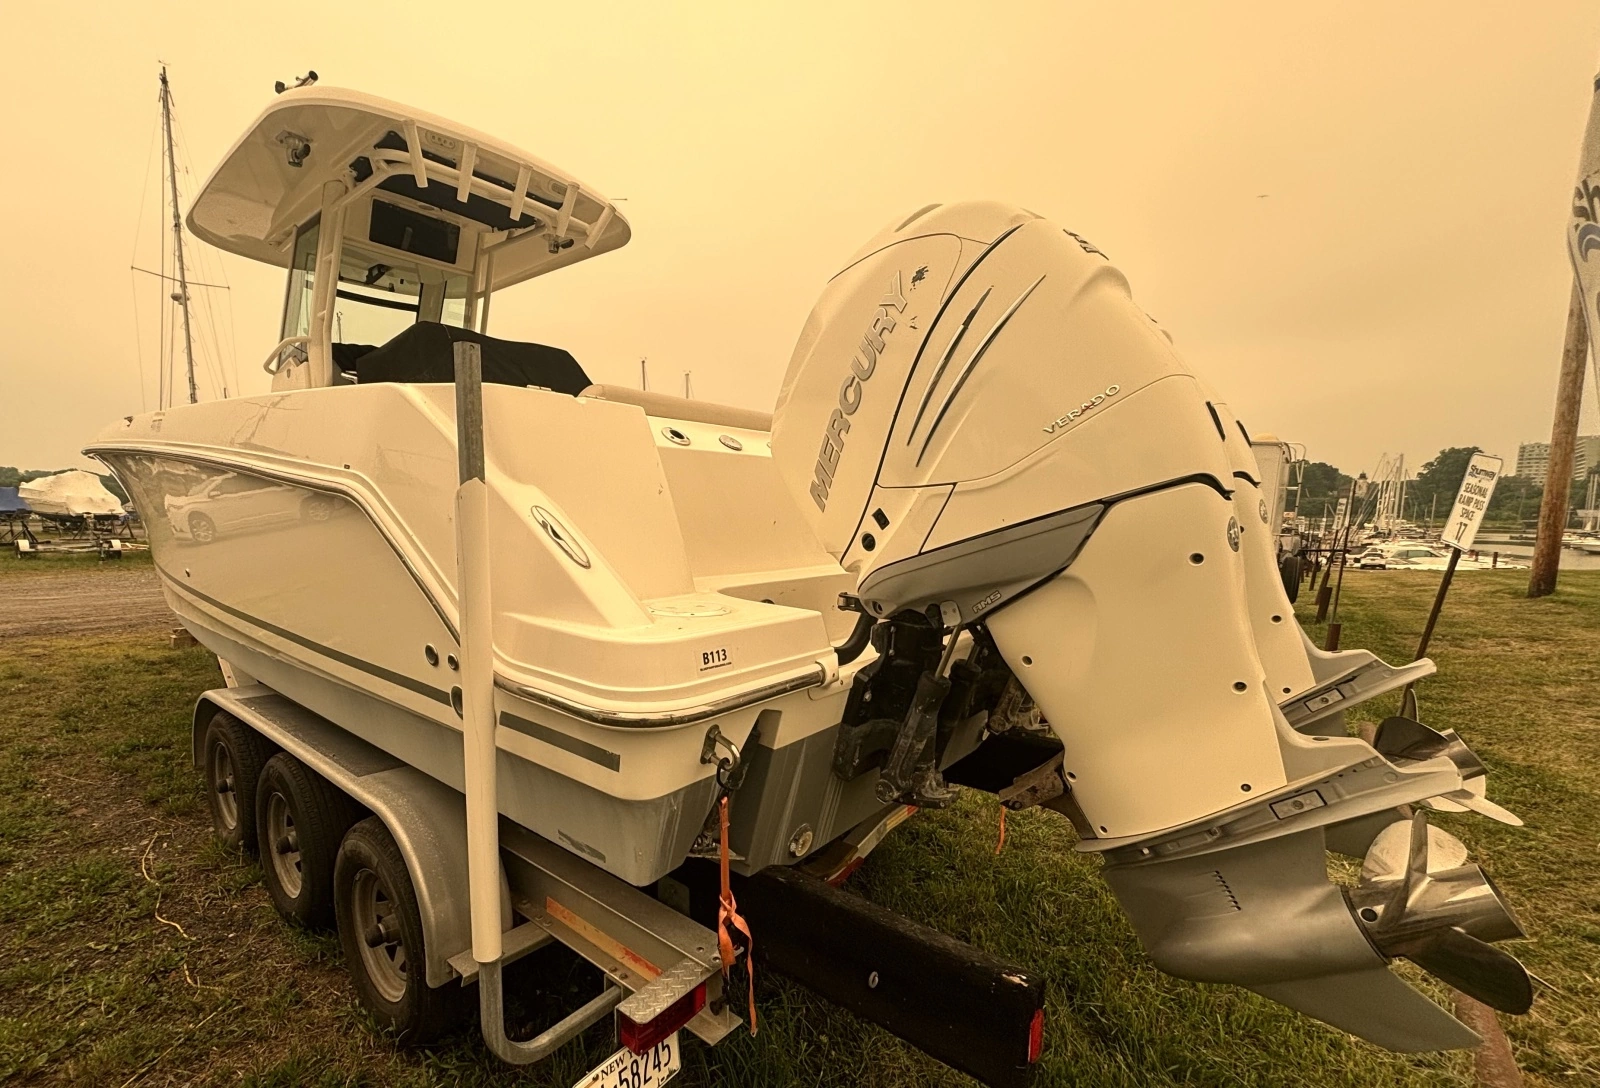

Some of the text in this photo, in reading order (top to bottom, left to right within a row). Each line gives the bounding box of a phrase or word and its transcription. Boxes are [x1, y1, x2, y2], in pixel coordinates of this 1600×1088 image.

[809, 270, 907, 513] MERCURY
[1042, 384, 1120, 434] VERADO
[1470, 464, 1497, 481] Shumway
[1463, 482, 1488, 499] SEASONAL
[1458, 494, 1486, 511] RAMP PASS
[1459, 507, 1475, 521] SPACE
[1455, 521, 1468, 543] 17
[972, 590, 1001, 613] AMS
[702, 648, 727, 665] B113
[601, 1040, 672, 1088] 58245
[601, 1053, 625, 1080] NEW
